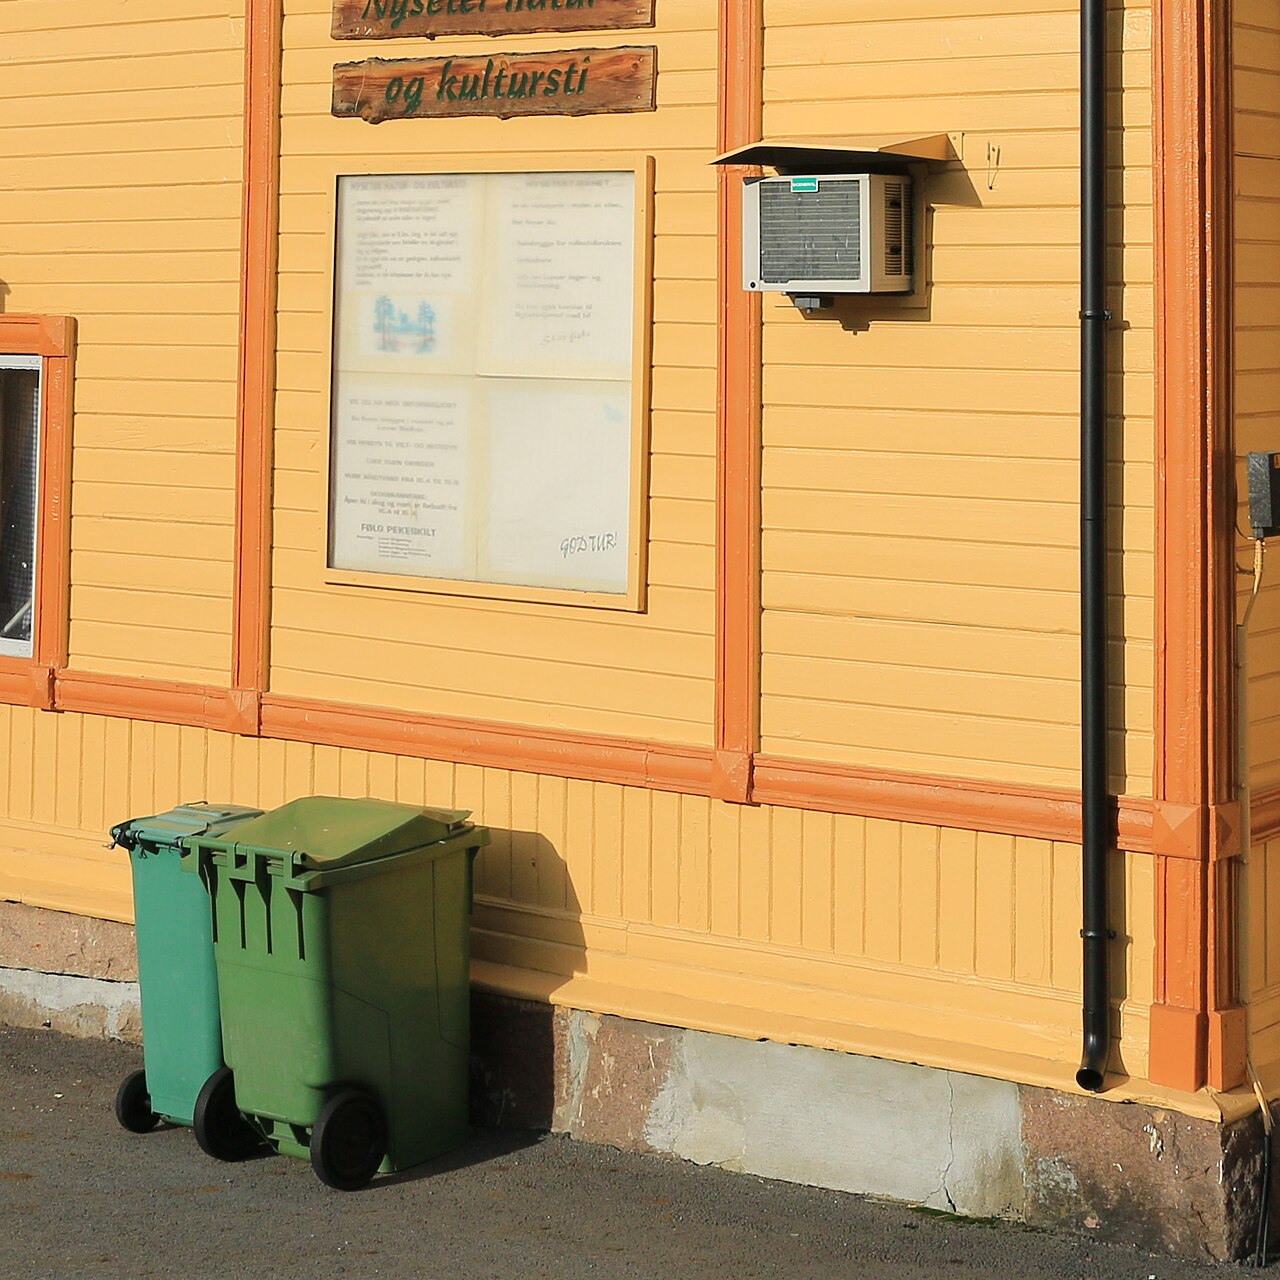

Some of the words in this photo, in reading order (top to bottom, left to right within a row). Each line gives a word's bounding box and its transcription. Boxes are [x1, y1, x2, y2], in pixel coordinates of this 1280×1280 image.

[385, 75, 424, 113] og
[437, 56, 591, 102] kultursti
[560, 535, 587, 559] GOD
